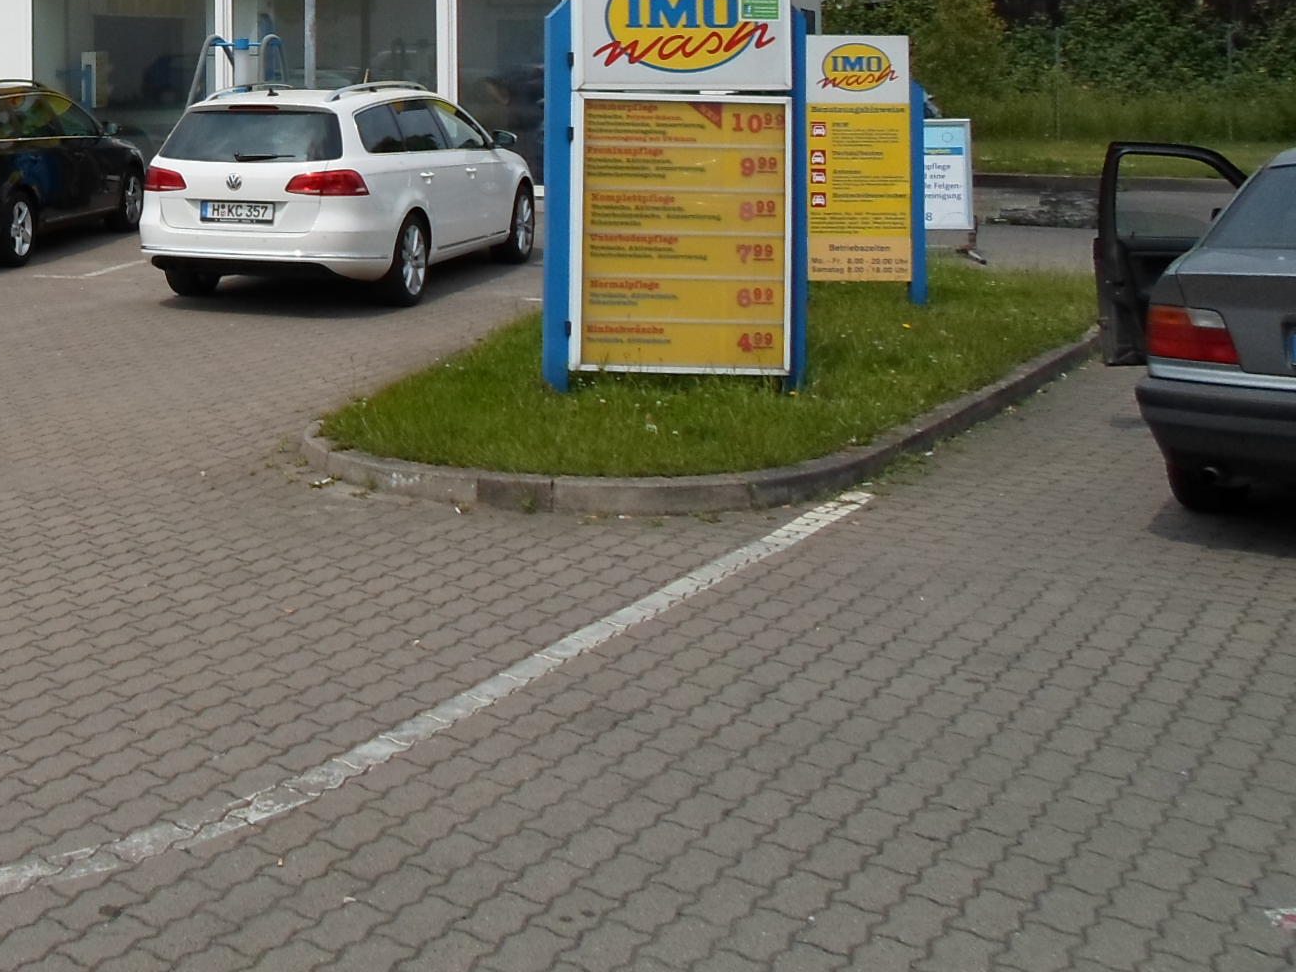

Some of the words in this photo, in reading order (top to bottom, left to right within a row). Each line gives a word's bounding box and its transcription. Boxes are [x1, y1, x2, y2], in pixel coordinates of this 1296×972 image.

[592, 18, 777, 67] wash
[831, 55, 882, 72] IMO
[816, 64, 900, 89] wash
[591, 192, 675, 203] Komplettpflege
[212, 203, 220, 216] H
[227, 204, 243, 217] KC
[245, 205, 268, 218] 357
[828, 243, 891, 252] Betriebszeiten
[811, 266, 845, 274] Samstag
[590, 280, 660, 290] Normalpflege
